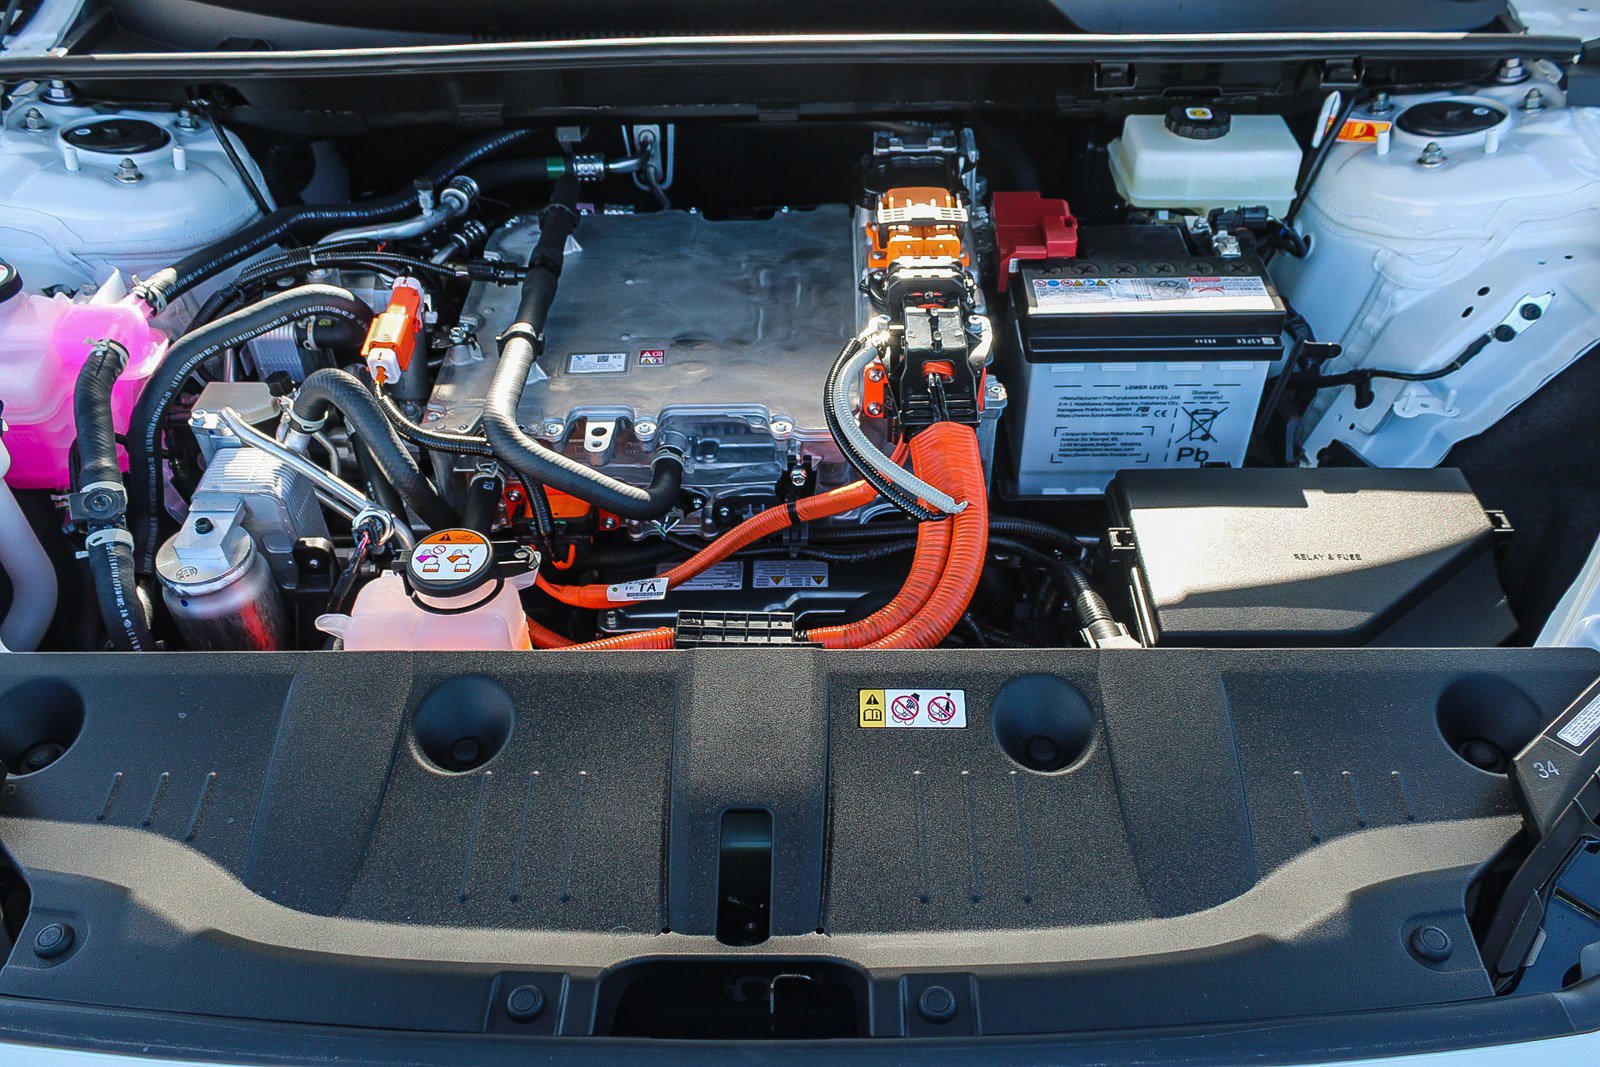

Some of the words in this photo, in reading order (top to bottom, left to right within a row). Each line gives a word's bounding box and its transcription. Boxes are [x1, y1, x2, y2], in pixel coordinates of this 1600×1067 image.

[1176, 446, 1210, 463] Pb
[640, 582, 657, 592] TA
[1533, 760, 1560, 778] 34
